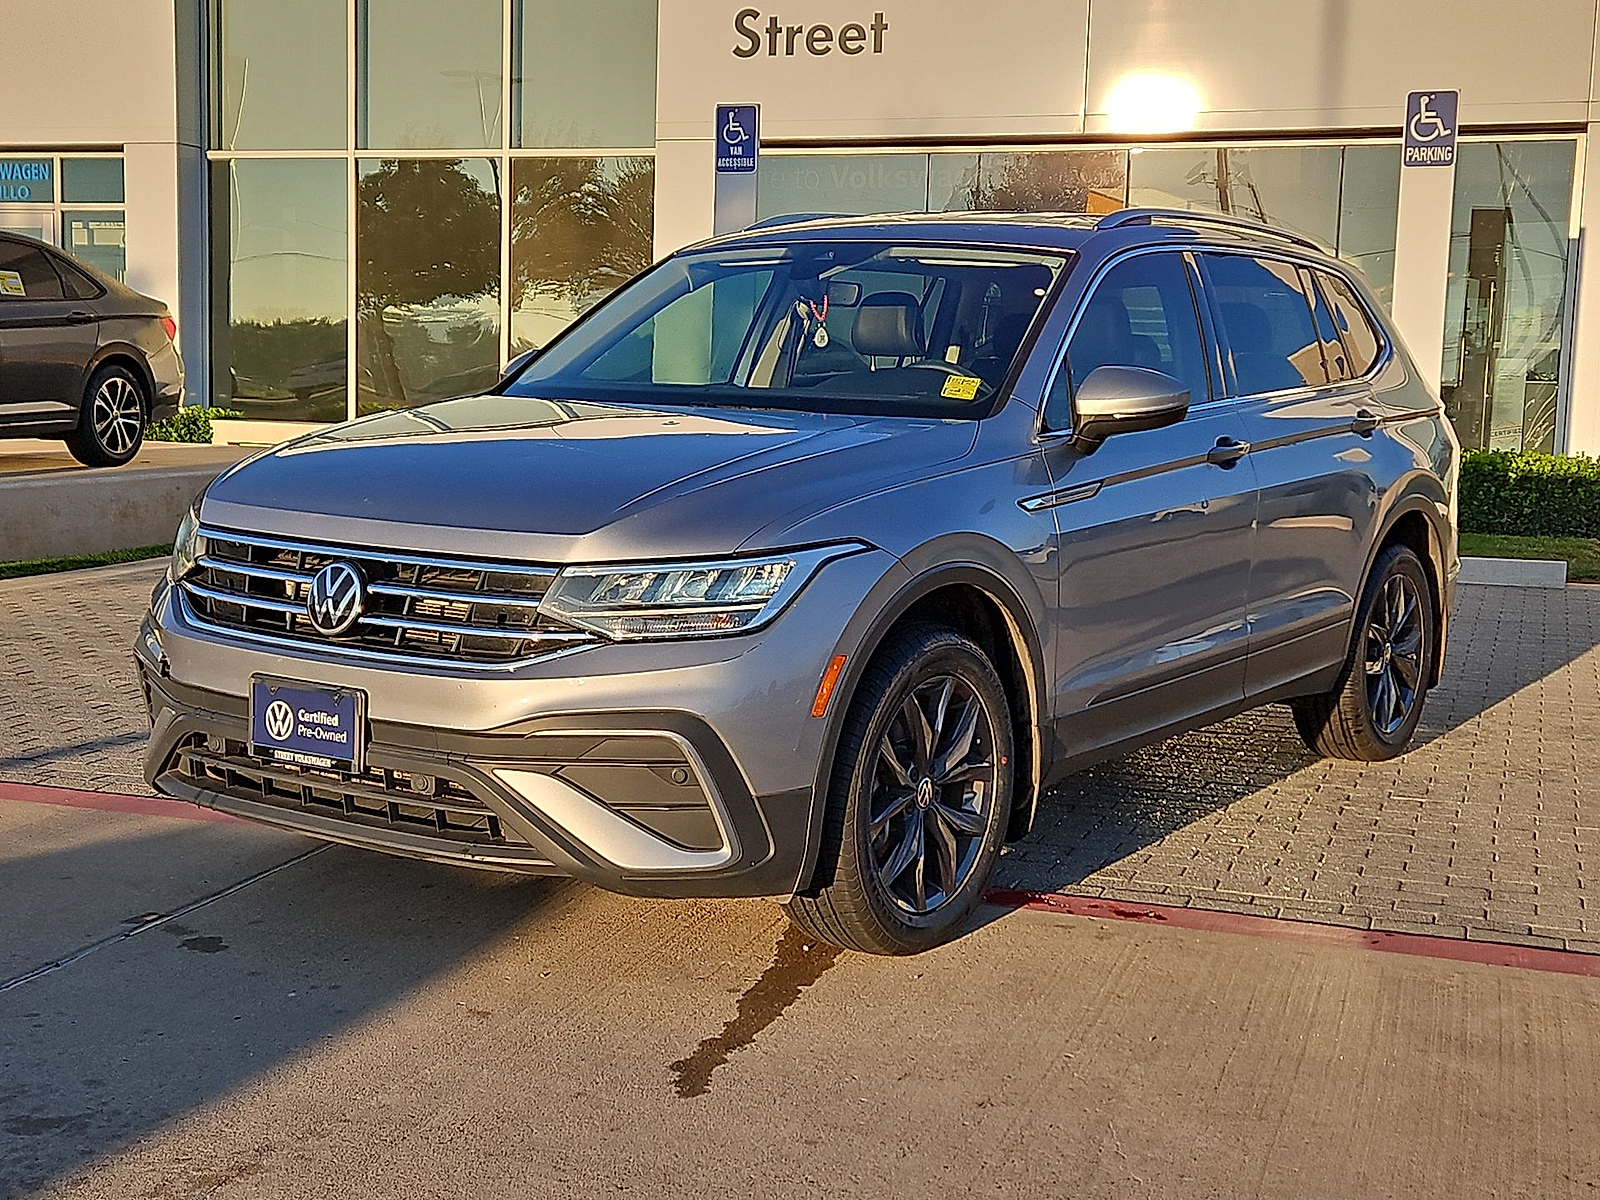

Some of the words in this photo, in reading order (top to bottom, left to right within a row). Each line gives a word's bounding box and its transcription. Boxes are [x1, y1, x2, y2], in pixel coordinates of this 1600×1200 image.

[731, 7, 889, 59] Street
[729, 145, 743, 156] VAN
[1406, 146, 1453, 162] PARKING
[717, 157, 754, 168] ACCESSIBLE
[794, 166, 820, 190] to
[298, 708, 339, 727] Certified
[298, 724, 347, 744] Pre-Owned
